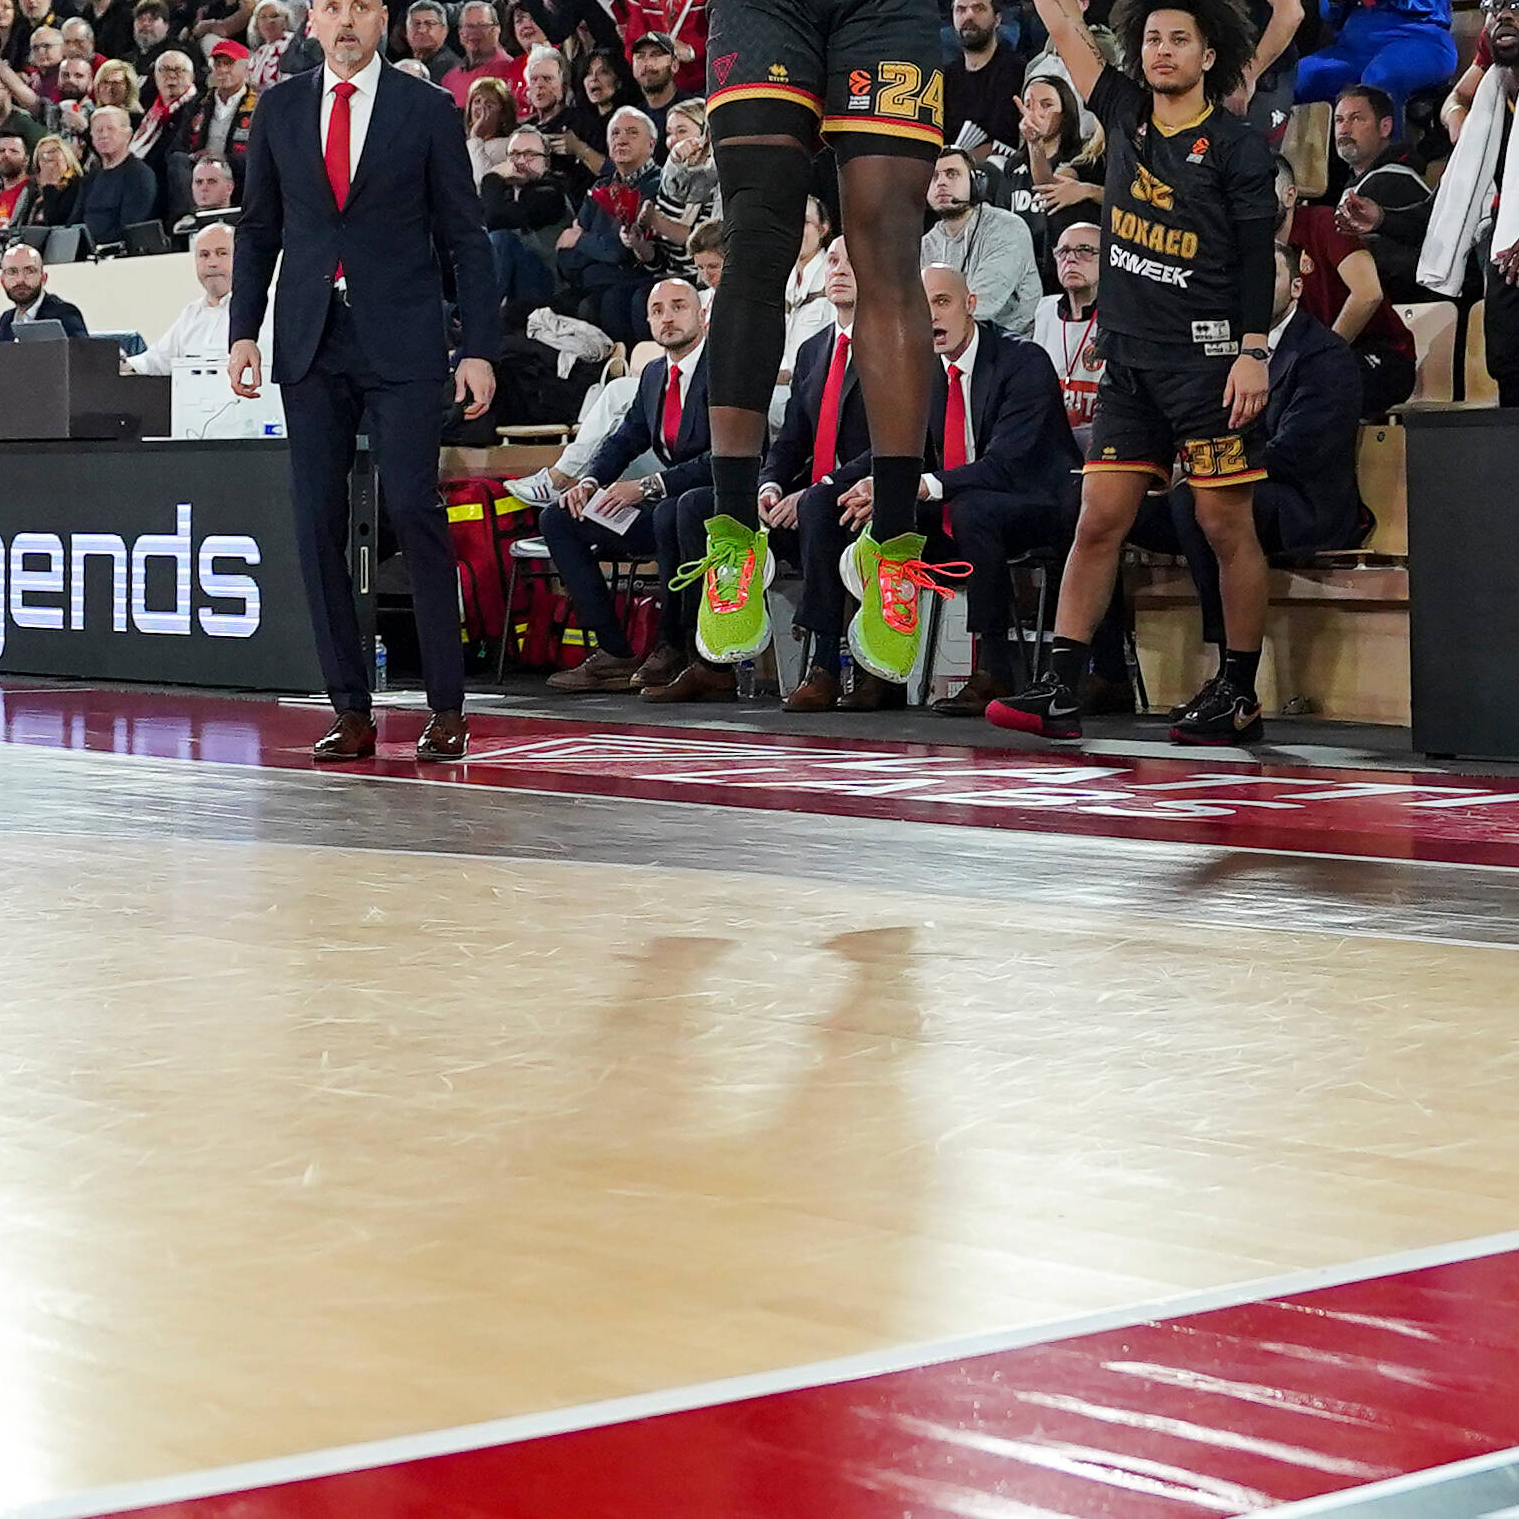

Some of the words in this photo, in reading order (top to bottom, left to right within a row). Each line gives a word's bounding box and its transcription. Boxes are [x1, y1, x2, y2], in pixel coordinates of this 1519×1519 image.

[874, 61, 944, 130] 24
[1111, 205, 1199, 259] MONACO
[1110, 244, 1194, 289] SKWEEK
[1185, 435, 1249, 477] 32
[634, 768, 1307, 818] LABS
